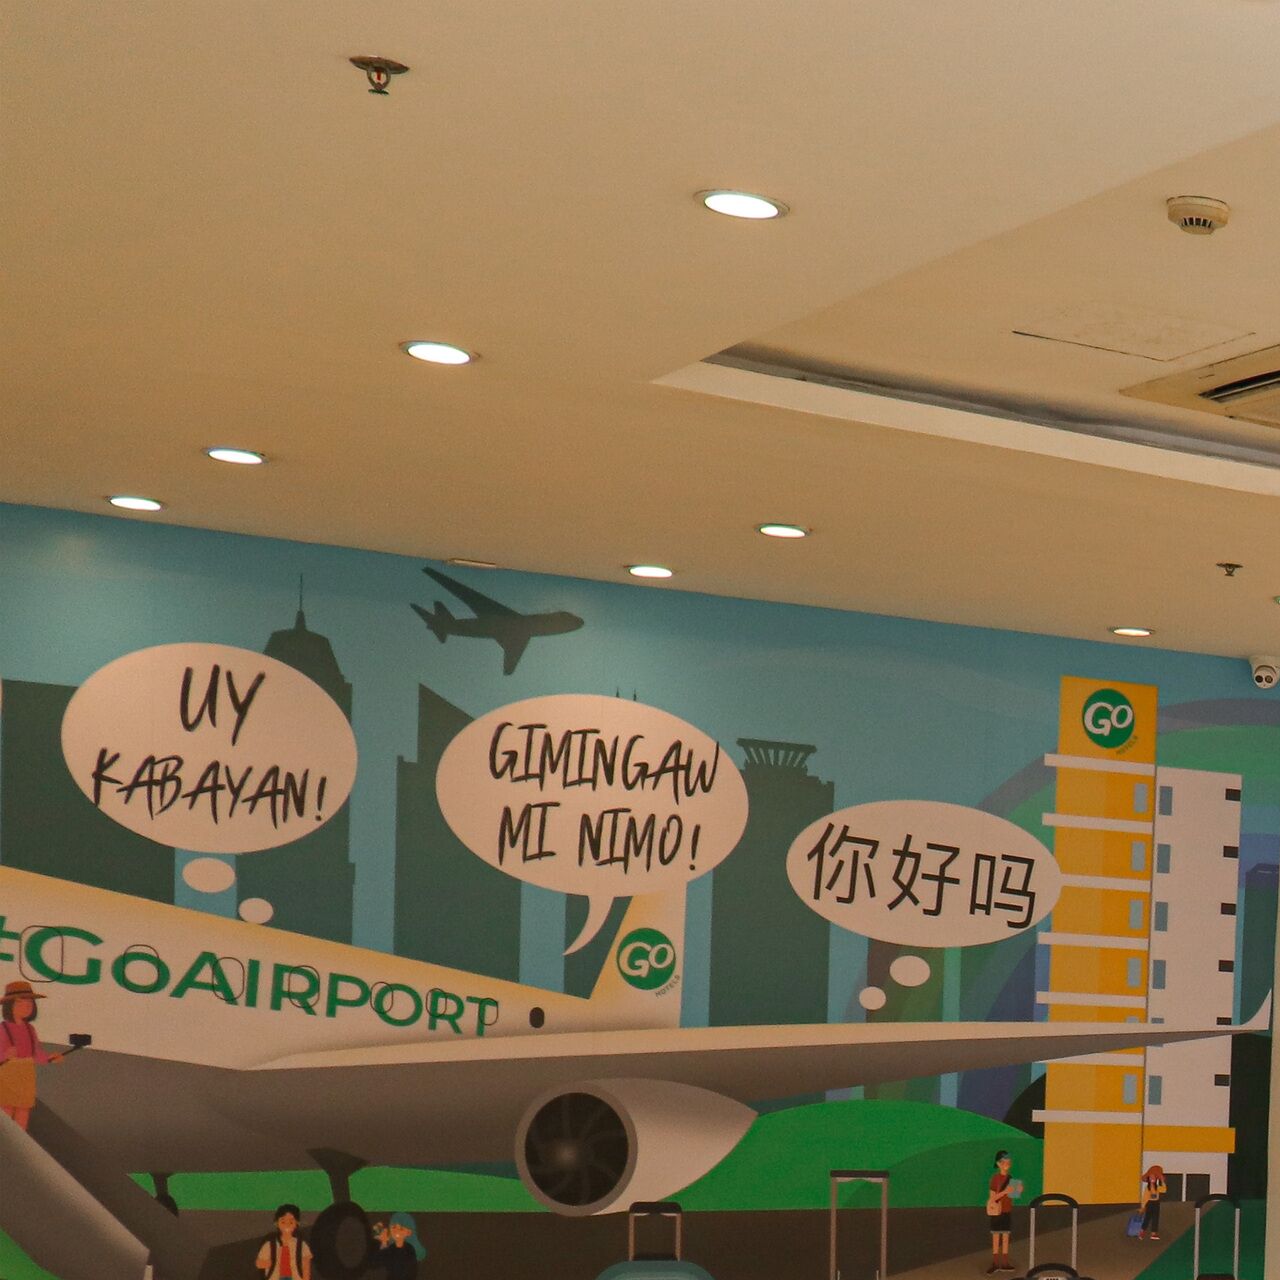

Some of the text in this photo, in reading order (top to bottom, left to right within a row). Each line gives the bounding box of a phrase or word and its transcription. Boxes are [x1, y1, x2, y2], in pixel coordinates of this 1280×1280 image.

[180, 664, 266, 747] UY
[92, 747, 327, 830] KABAYAN!
[489, 722, 719, 806] GIMINGAW
[498, 801, 701, 875] MI NIMO!
[807, 822, 1036, 929] 你好吗
